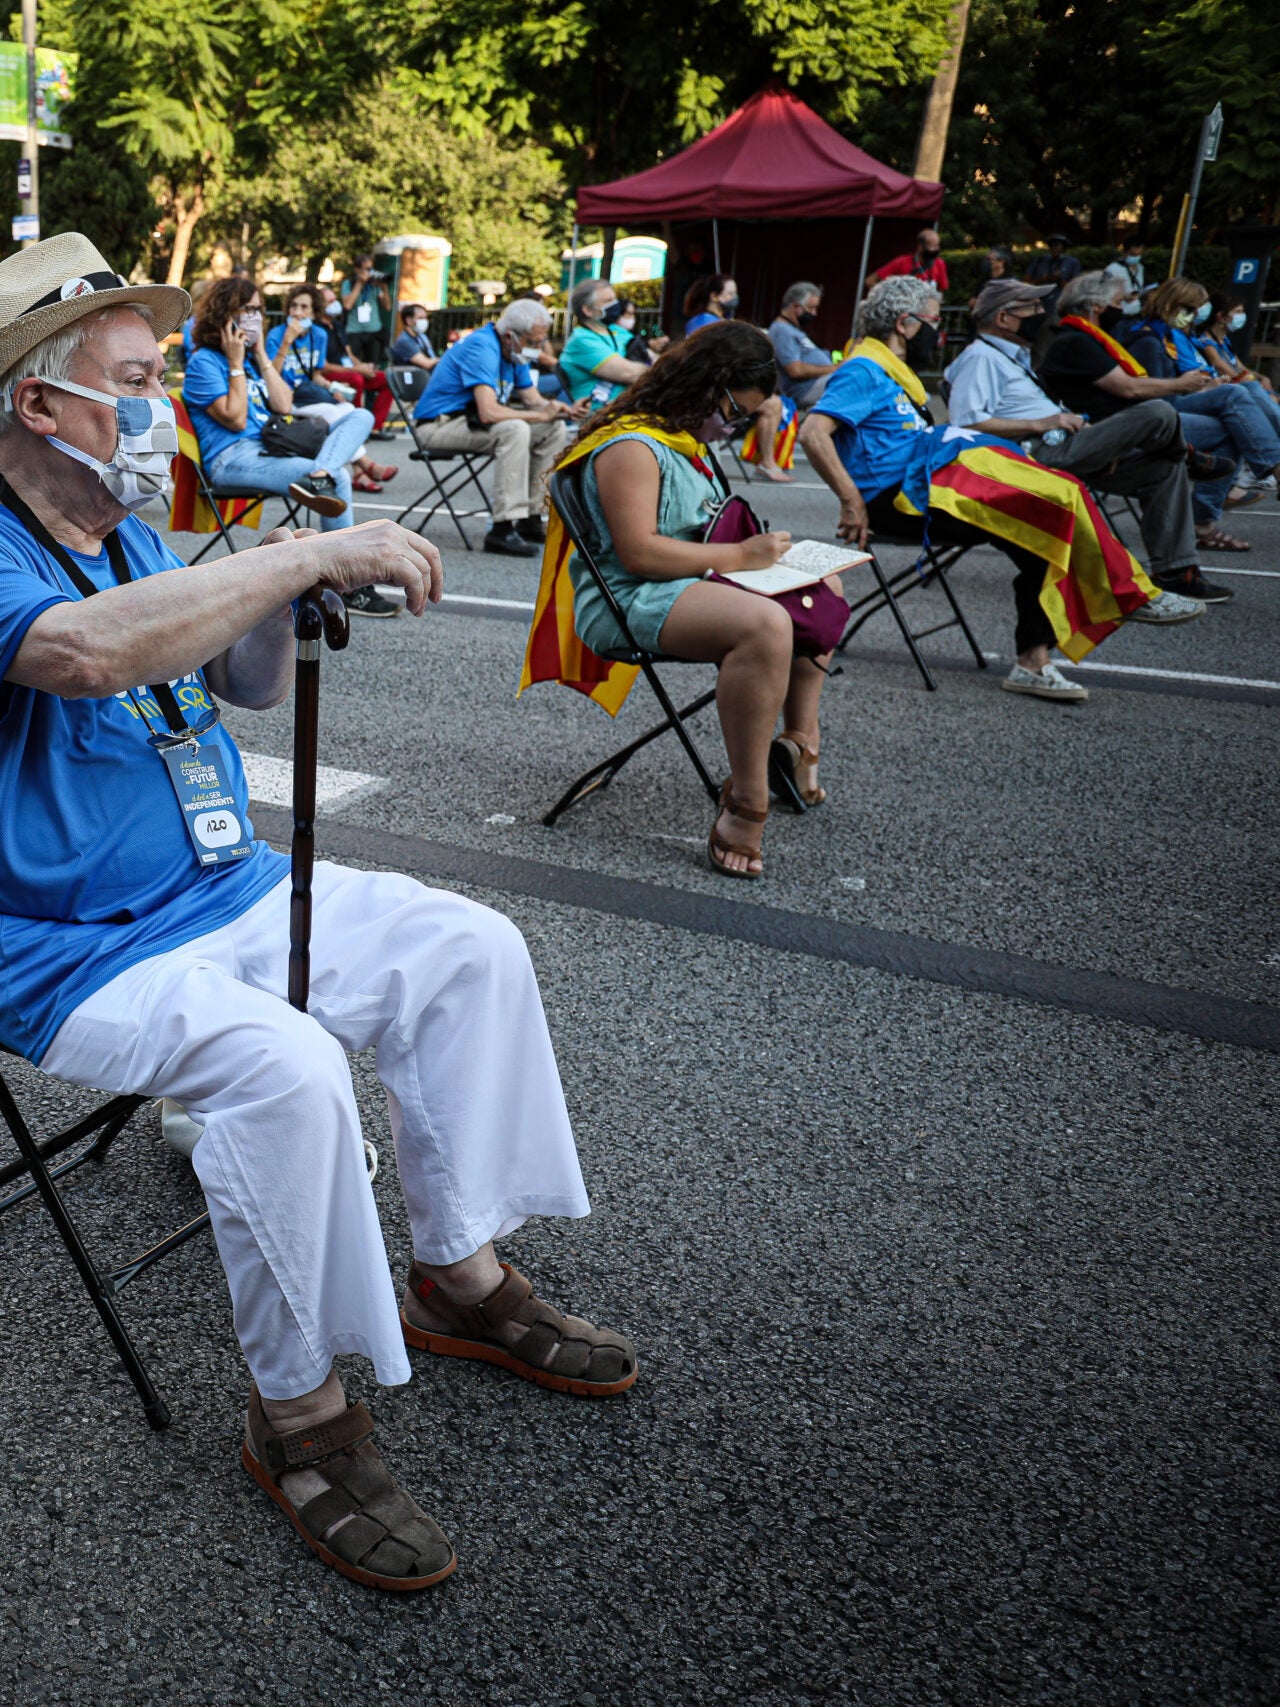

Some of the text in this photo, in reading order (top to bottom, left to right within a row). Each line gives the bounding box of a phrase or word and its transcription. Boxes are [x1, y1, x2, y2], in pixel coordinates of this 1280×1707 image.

[1237, 262, 1254, 280] P
[182, 765, 215, 775] CONSTRUIR
[189, 772, 218, 785] FUTUR
[199, 781, 221, 790] MILLOR
[209, 791, 221, 799] SER
[184, 797, 234, 811] INDEPENDENTS
[207, 819, 227, 833] 120
